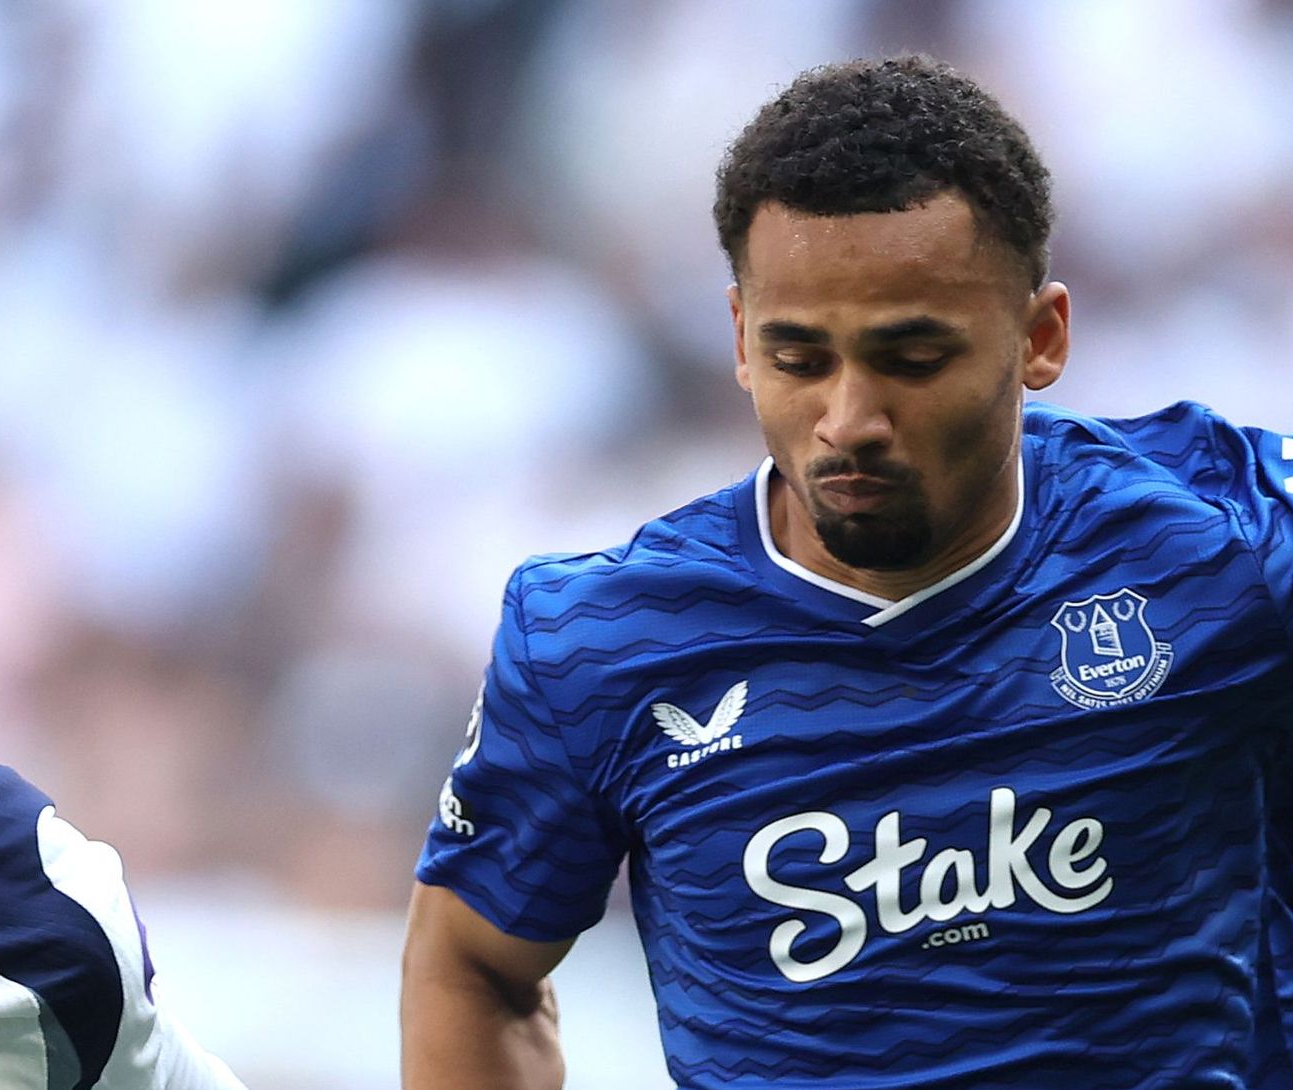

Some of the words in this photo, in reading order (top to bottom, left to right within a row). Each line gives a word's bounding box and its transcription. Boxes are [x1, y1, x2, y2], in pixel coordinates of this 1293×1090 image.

[1077, 654, 1146, 682] Everton
[1133, 658, 1169, 700] OPTIMUM
[742, 785, 1114, 984] Stake
[920, 919, 991, 951] .com
